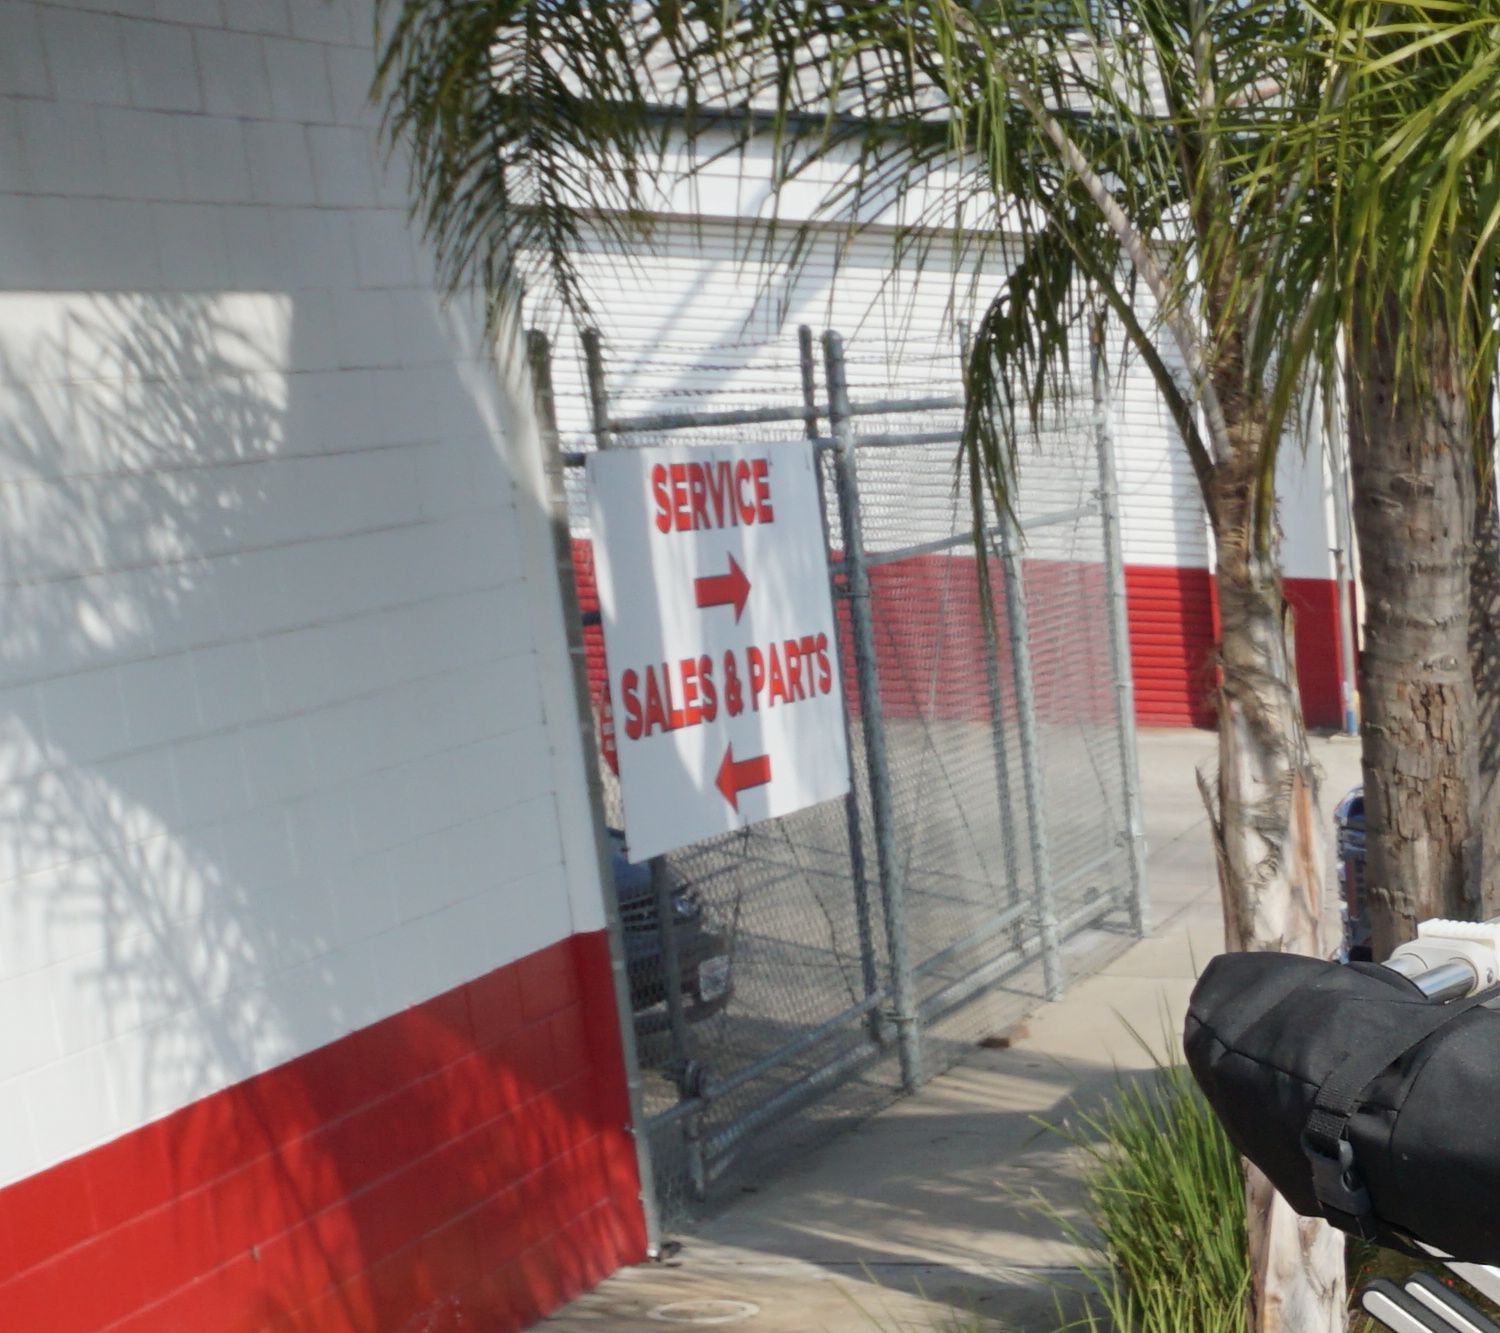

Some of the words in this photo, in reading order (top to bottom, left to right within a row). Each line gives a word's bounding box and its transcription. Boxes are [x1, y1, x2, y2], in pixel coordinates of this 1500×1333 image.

[651, 458, 774, 534] SERVICE
[621, 656, 717, 740] SALES
[724, 650, 744, 717] &
[746, 632, 834, 710] PARTS
